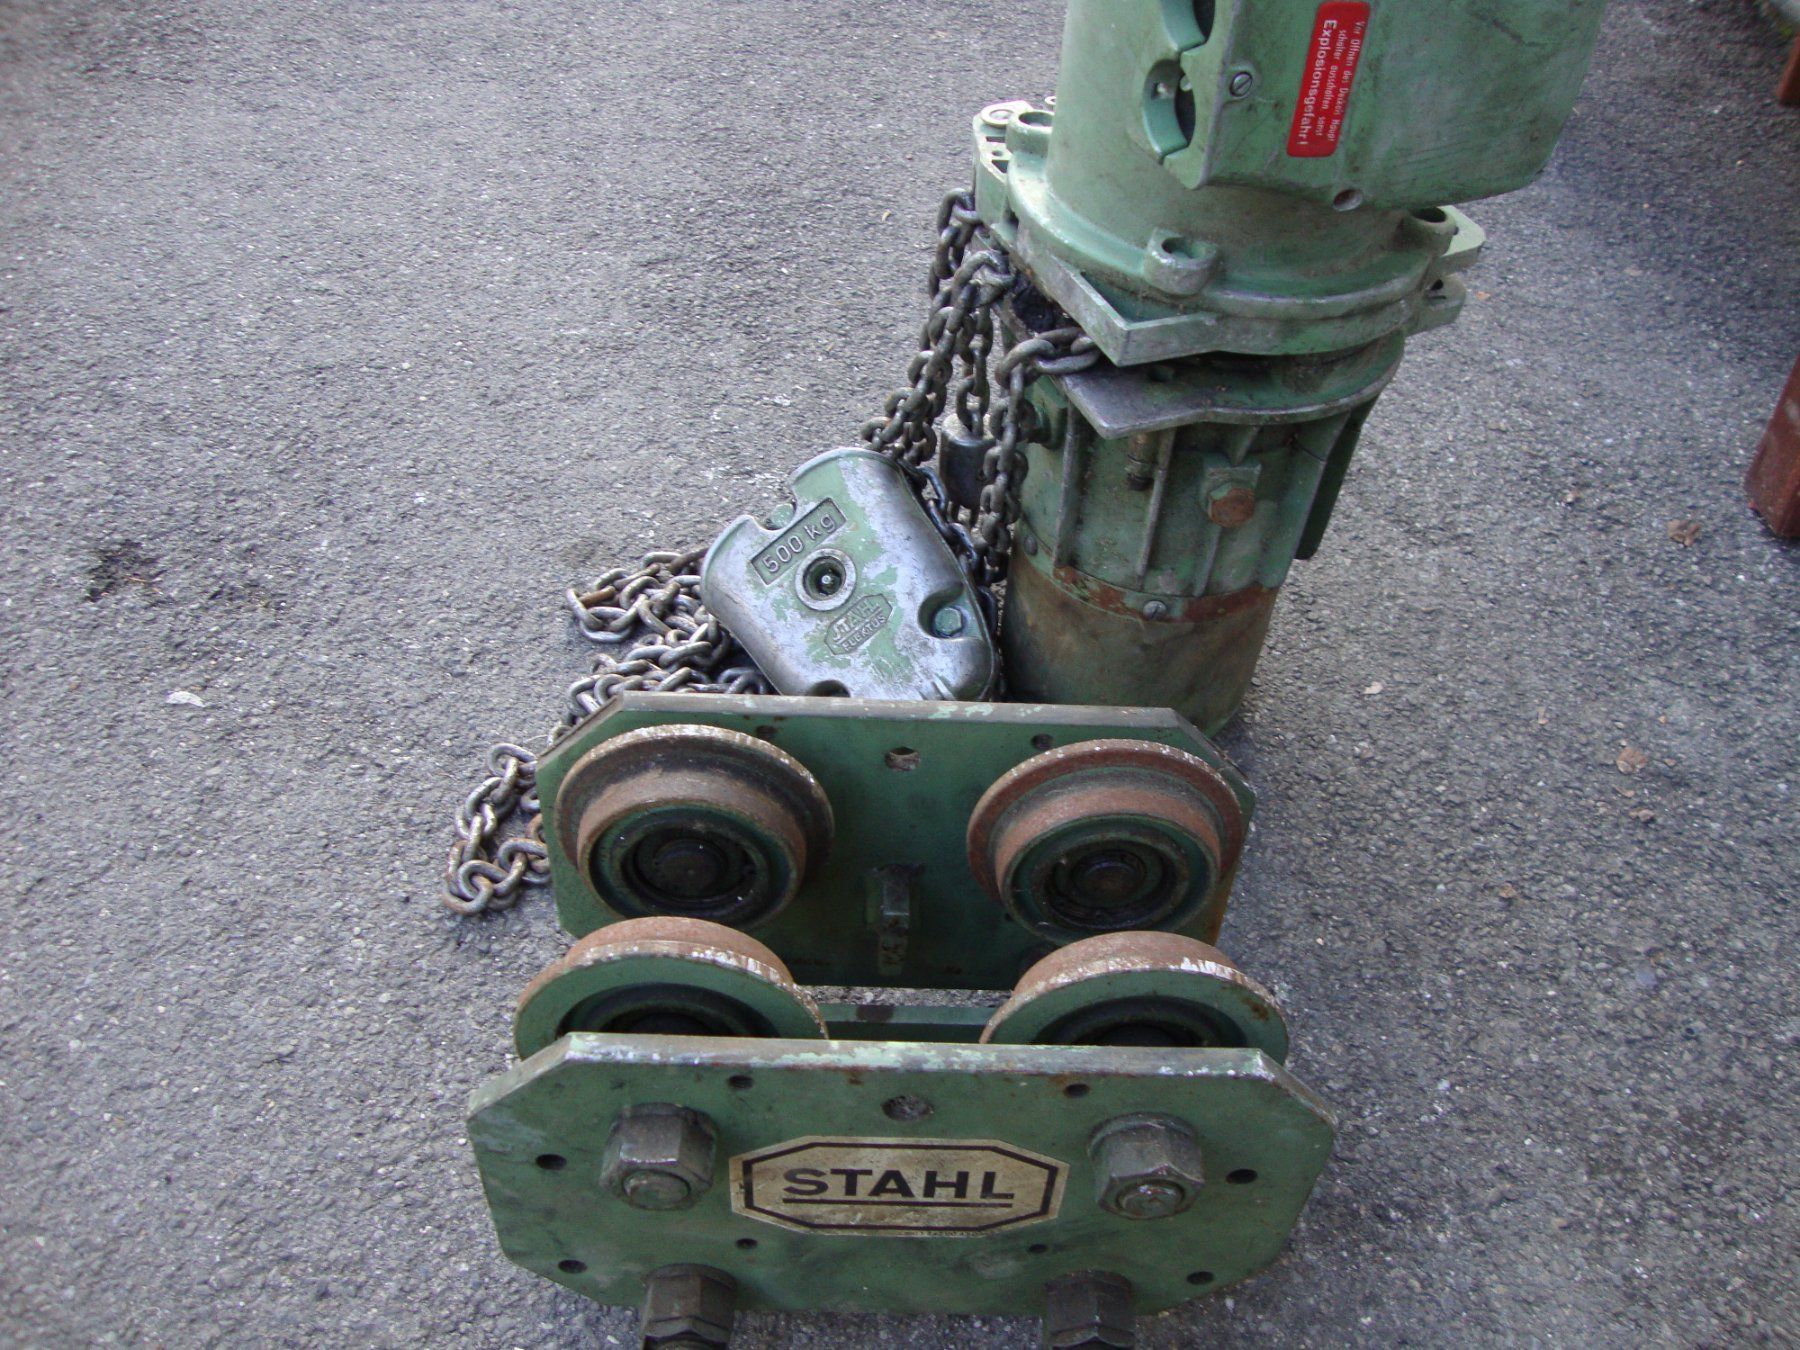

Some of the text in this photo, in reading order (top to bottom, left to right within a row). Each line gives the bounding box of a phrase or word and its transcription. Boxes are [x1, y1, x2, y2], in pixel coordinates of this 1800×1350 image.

[763, 513, 836, 573] 500 kg
[783, 1168, 1014, 1200] STAHL
